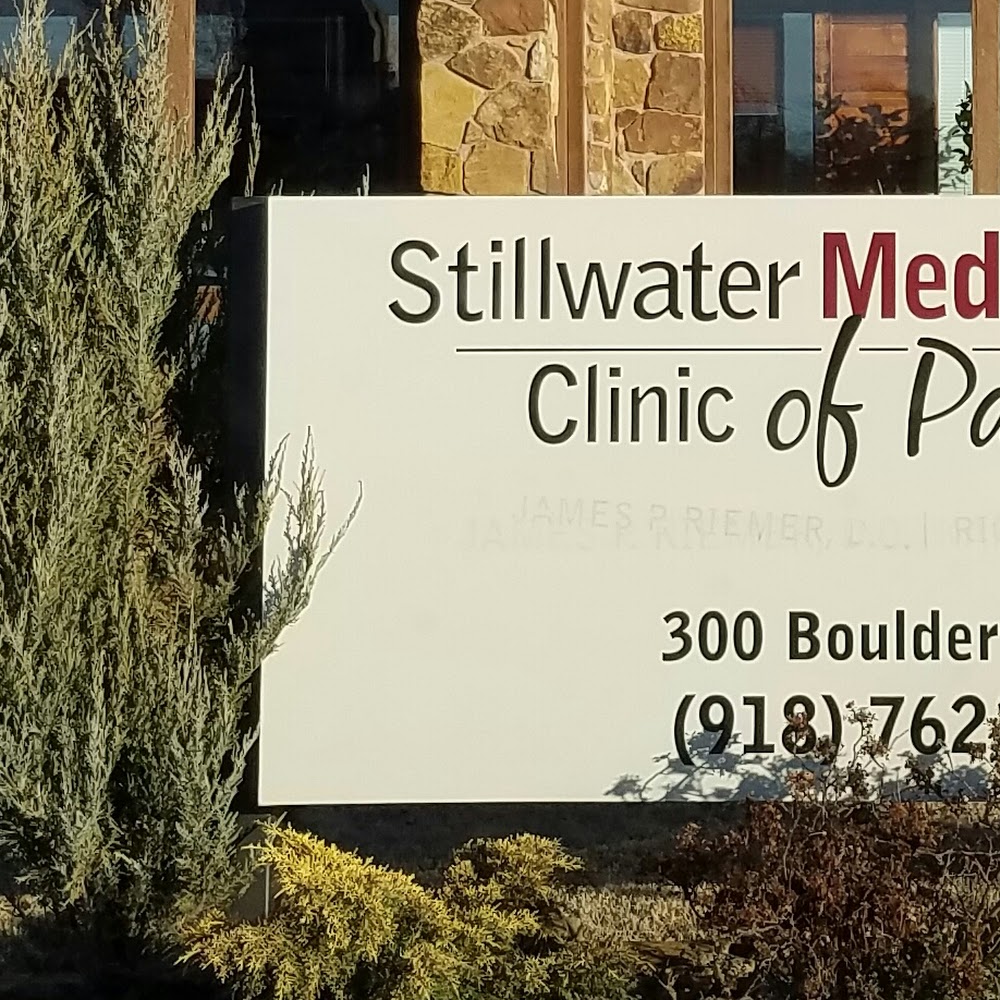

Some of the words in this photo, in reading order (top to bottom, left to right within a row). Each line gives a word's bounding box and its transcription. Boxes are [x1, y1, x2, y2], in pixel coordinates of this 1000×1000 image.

[388, 237, 801, 323] Stillwater
[528, 364, 735, 444] Clinic
[766, 314, 864, 488] of
[662, 610, 763, 662] 300
[788, 609, 998, 661] Boulder
[674, 693, 843, 766] (918)
